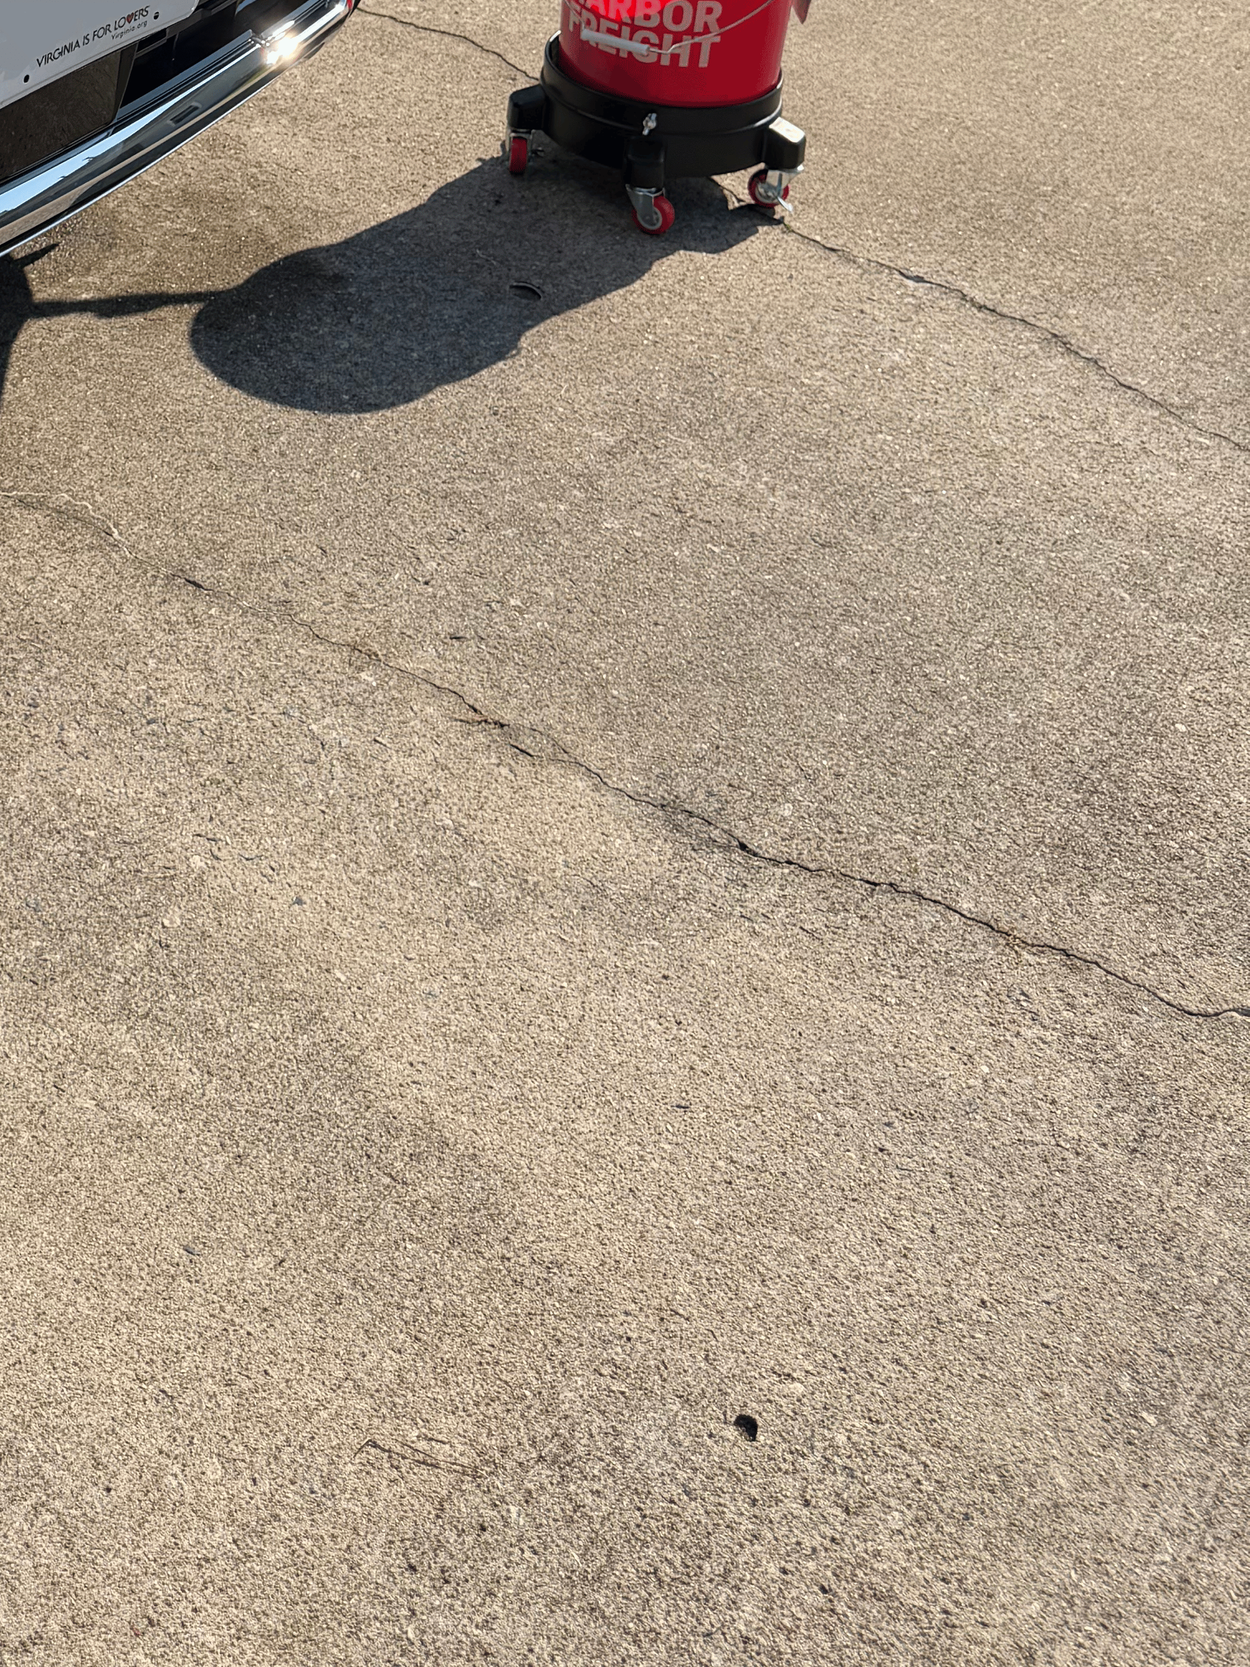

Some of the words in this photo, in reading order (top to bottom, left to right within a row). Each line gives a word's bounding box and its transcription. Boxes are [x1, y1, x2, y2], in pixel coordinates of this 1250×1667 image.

[36, 39, 81, 68] VIRGINIA
[82, 33, 90, 46] IS
[92, 23, 112, 42] FOR
[111, 19, 148, 40] Virginia.org
[568, 0, 721, 68] FREIGHT
